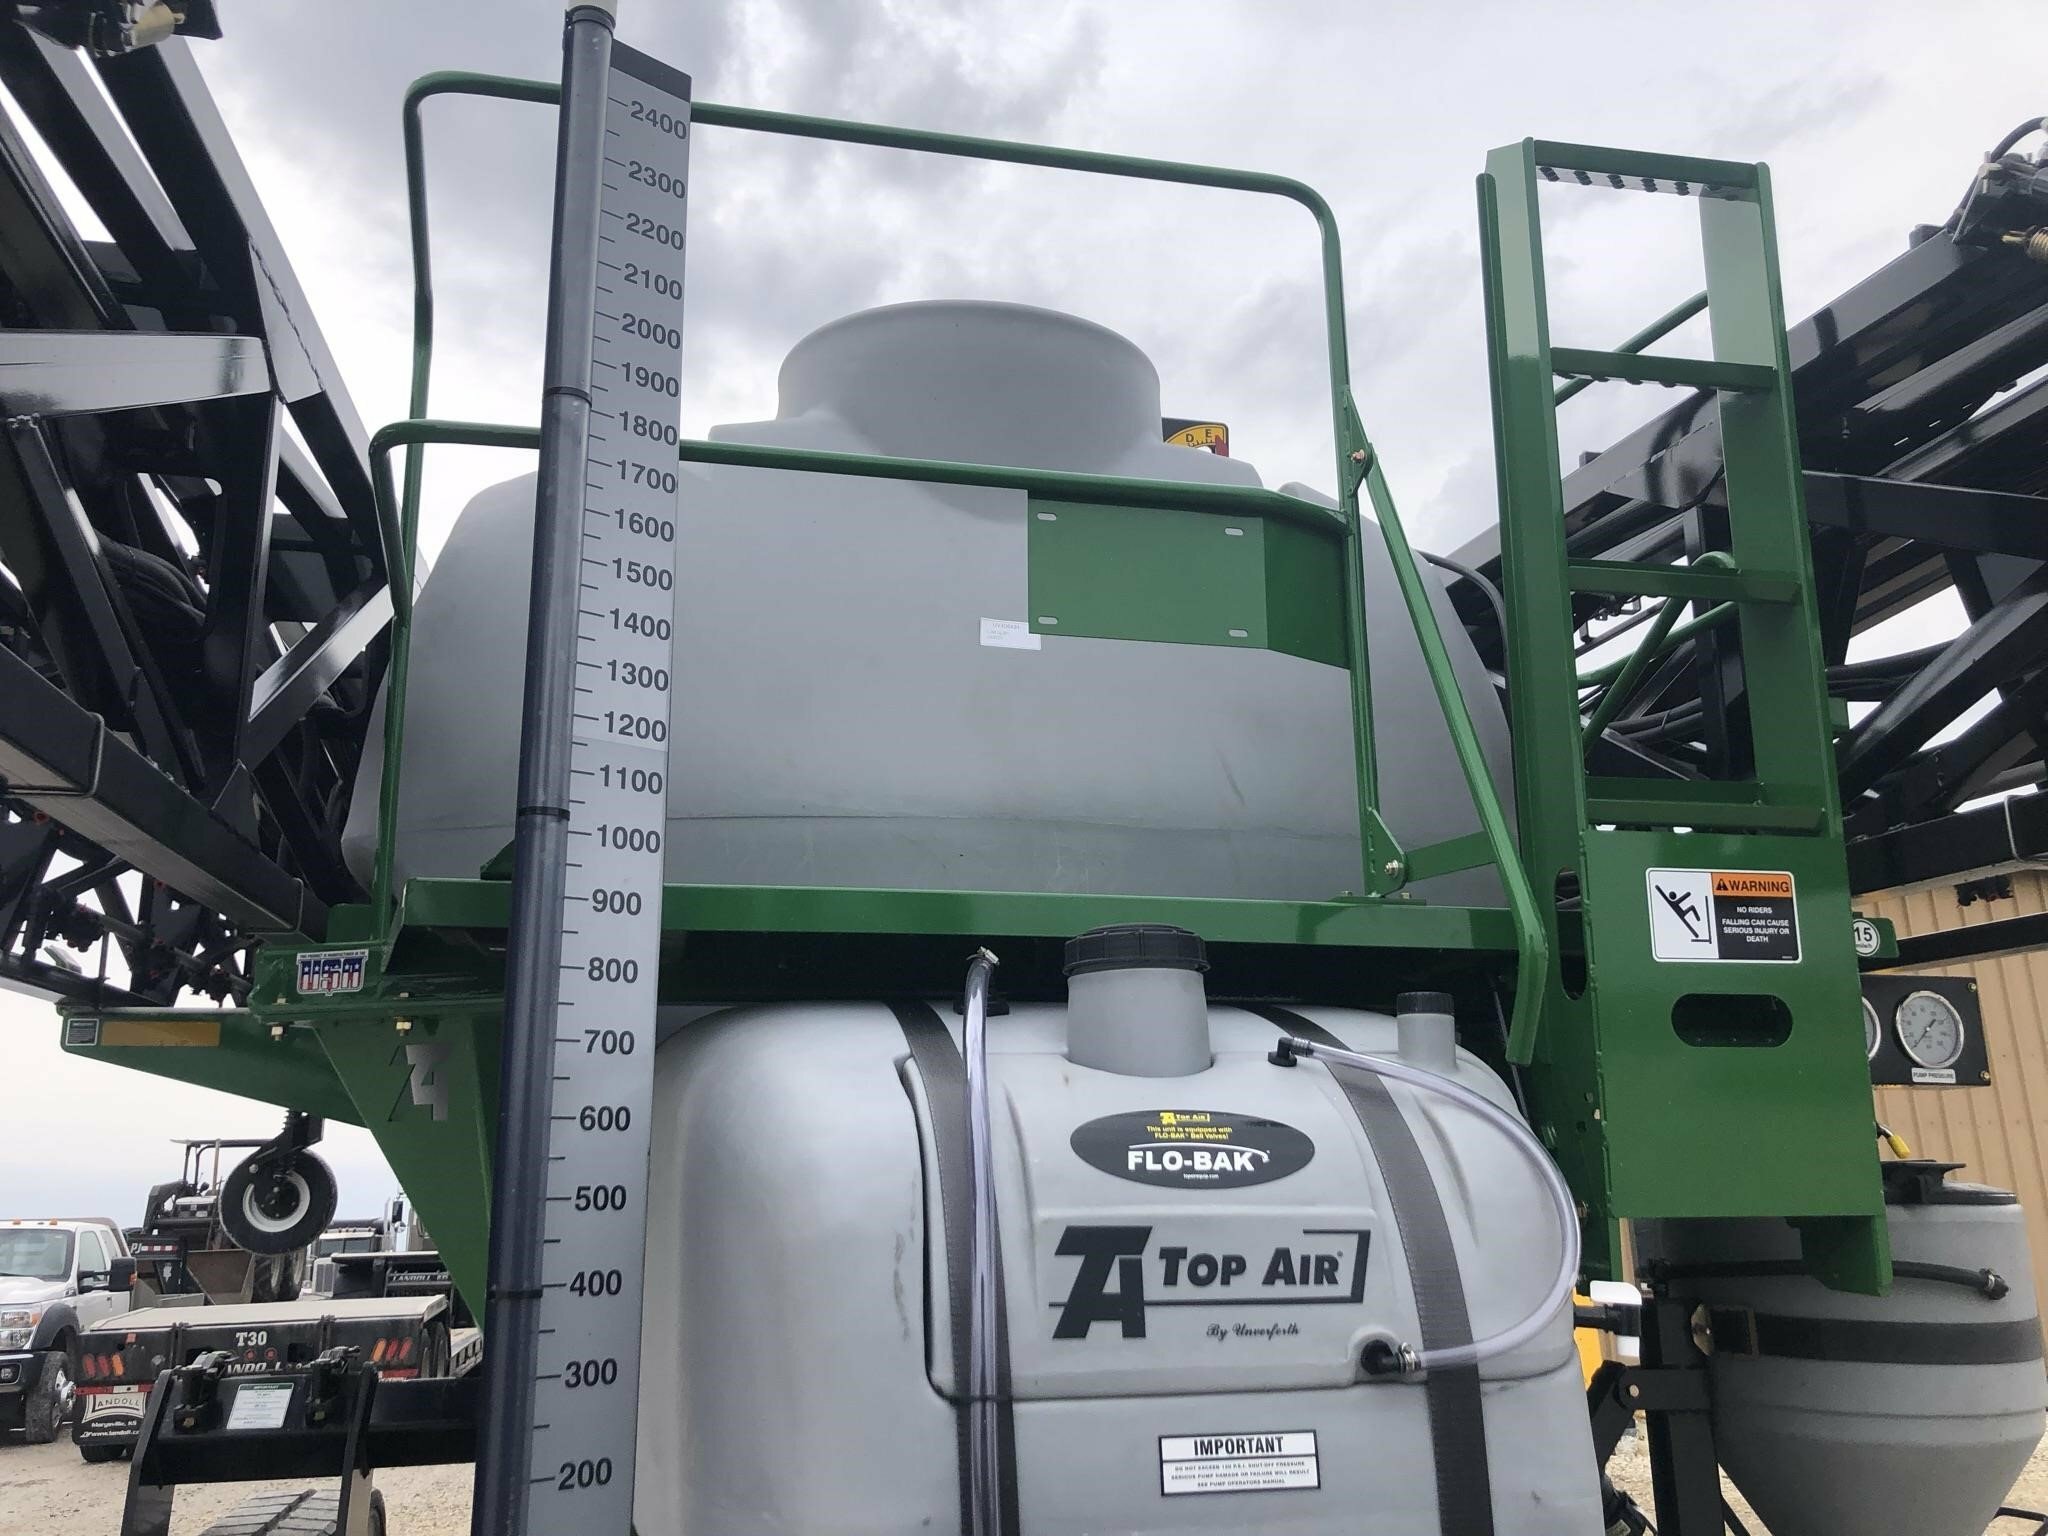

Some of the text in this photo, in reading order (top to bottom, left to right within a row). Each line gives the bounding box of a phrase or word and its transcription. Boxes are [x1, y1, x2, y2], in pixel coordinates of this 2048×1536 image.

[630, 100, 687, 141] 2400
[628, 160, 686, 200] 2300
[626, 212, 684, 251] 2200
[623, 262, 683, 301] 2100
[621, 312, 681, 350] 2000
[620, 362, 679, 398] 1900
[618, 411, 678, 446] 1800
[616, 459, 677, 494] 1700
[614, 508, 675, 543] 1600
[611, 557, 673, 591] 1500
[609, 607, 671, 641] 1400
[606, 659, 669, 692] 1300
[603, 711, 667, 742] 1200
[599, 764, 663, 795] 1100
[596, 824, 661, 853] 1000
[1729, 879, 1789, 893] WARNING
[591, 888, 642, 916] 900
[1722, 918, 1750, 926] FALLING
[1754, 927, 1778, 935] INJURY
[1854, 926, 1872, 942] 15
[1746, 935, 1769, 943] DEATH
[300, 957, 364, 992] USA
[587, 956, 639, 984] 800
[584, 1029, 635, 1055] 700
[578, 1105, 631, 1132] 600
[1127, 1151, 1254, 1172] FLO-BAK
[574, 1184, 627, 1211] 500
[130, 1243, 143, 1254] PJ
[569, 1269, 623, 1298] 400
[236, 1331, 268, 1346] T30
[1206, 1323, 1228, 1340] By
[564, 1358, 618, 1388] 300
[1193, 1436, 1284, 1456] IMPORTANT
[557, 1457, 613, 1491] 200
